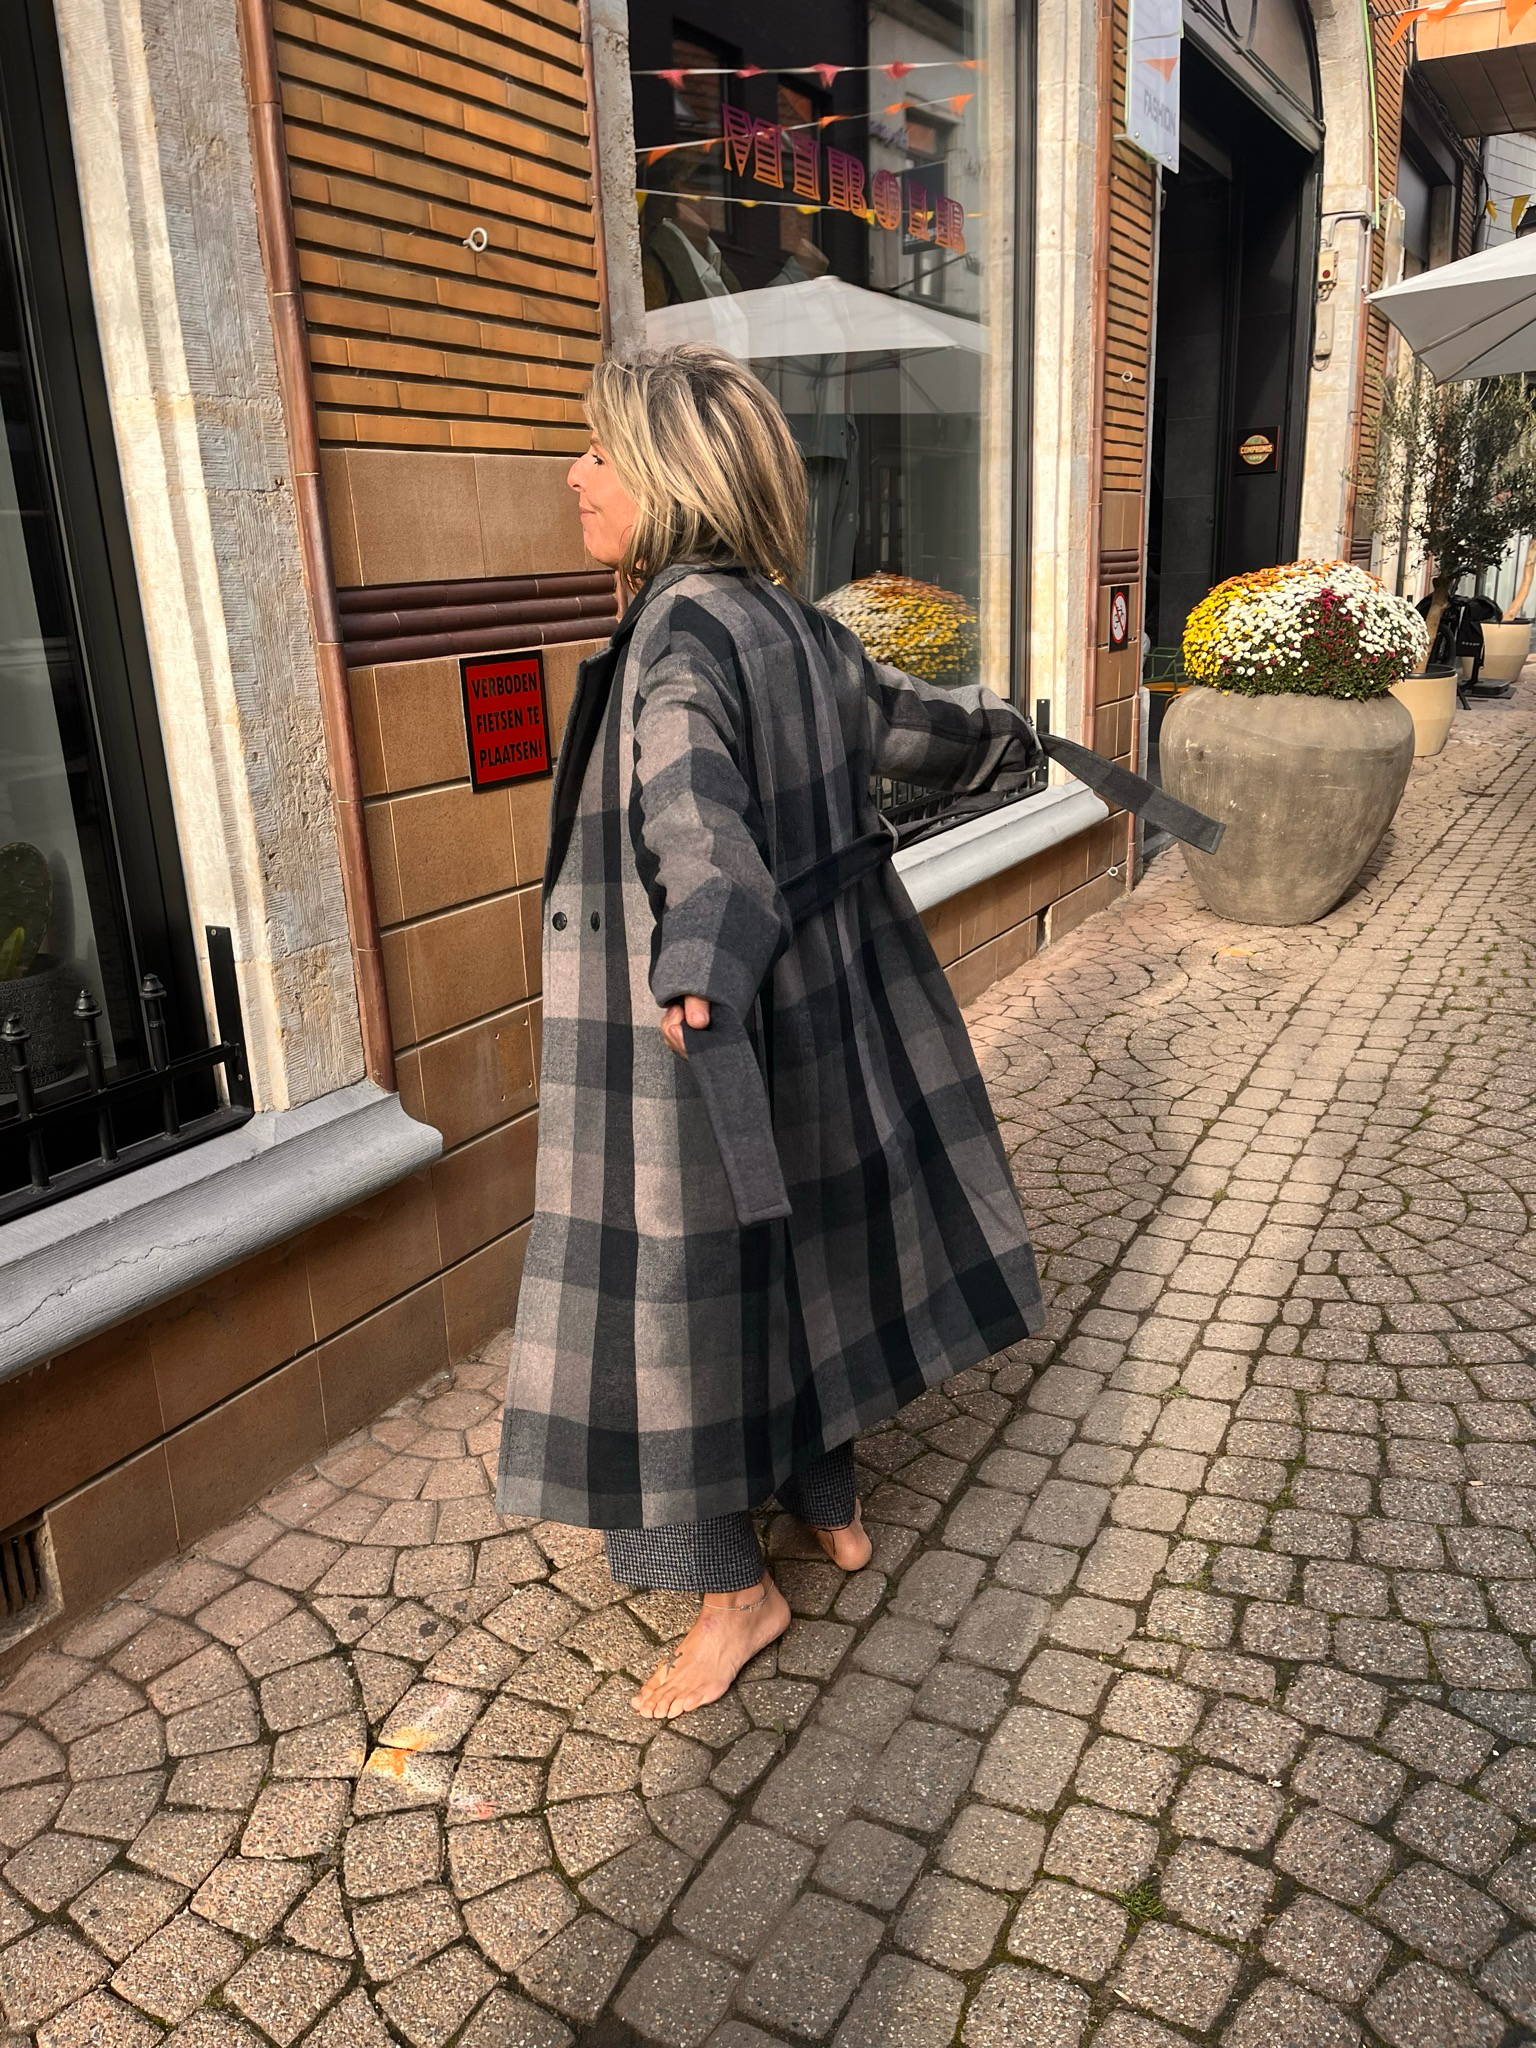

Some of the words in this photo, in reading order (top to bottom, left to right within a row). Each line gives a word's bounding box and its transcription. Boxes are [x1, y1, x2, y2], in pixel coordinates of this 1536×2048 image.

[1143, 88, 1177, 137] FASHION
[470, 671, 538, 700] VERBODEN
[475, 707, 524, 735] FIETSEN
[526, 705, 540, 726] TE
[478, 738, 543, 769] PLAATSEN!
